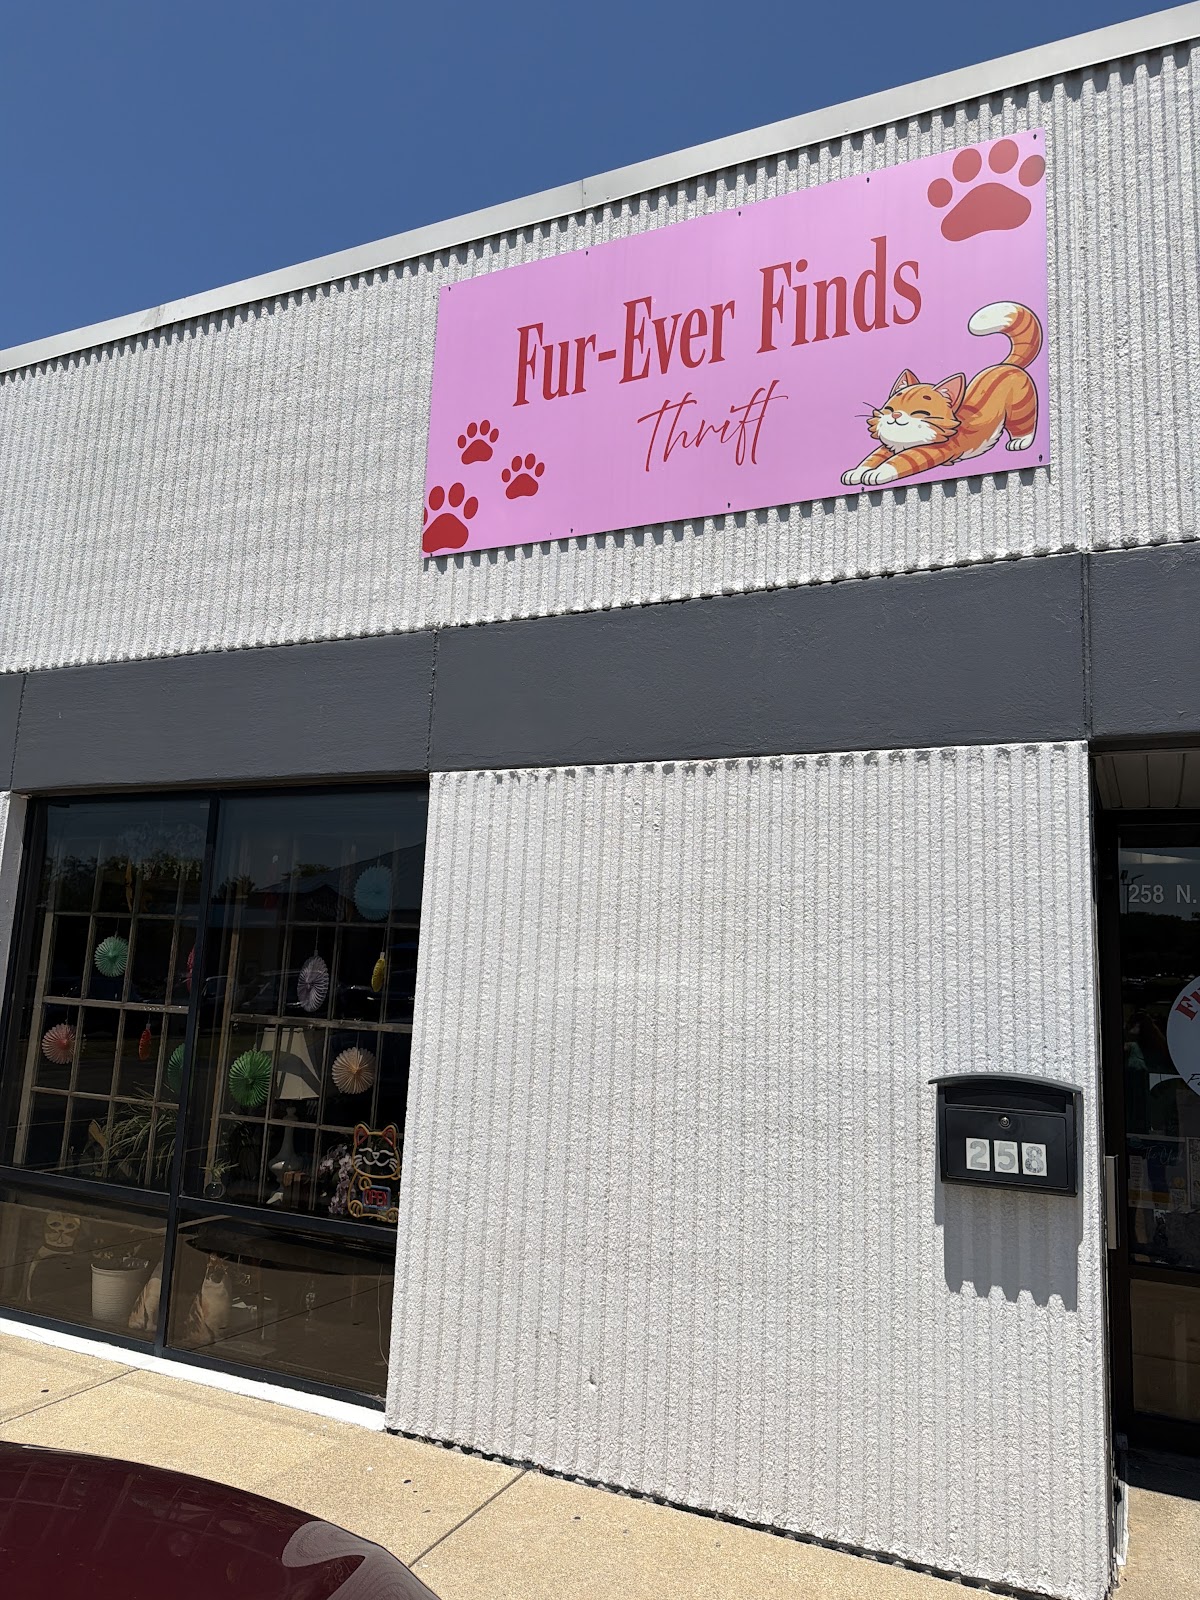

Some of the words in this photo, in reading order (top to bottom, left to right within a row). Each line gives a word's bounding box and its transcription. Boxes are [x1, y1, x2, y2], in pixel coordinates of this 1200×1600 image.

[513, 296, 736, 407] Fur-Ever
[756, 236, 922, 355] Finds
[1128, 884, 1164, 904] 258
[1176, 884, 1197, 904] N.
[969, 1140, 1045, 1174] 258
[364, 1189, 388, 1207] OPEN
